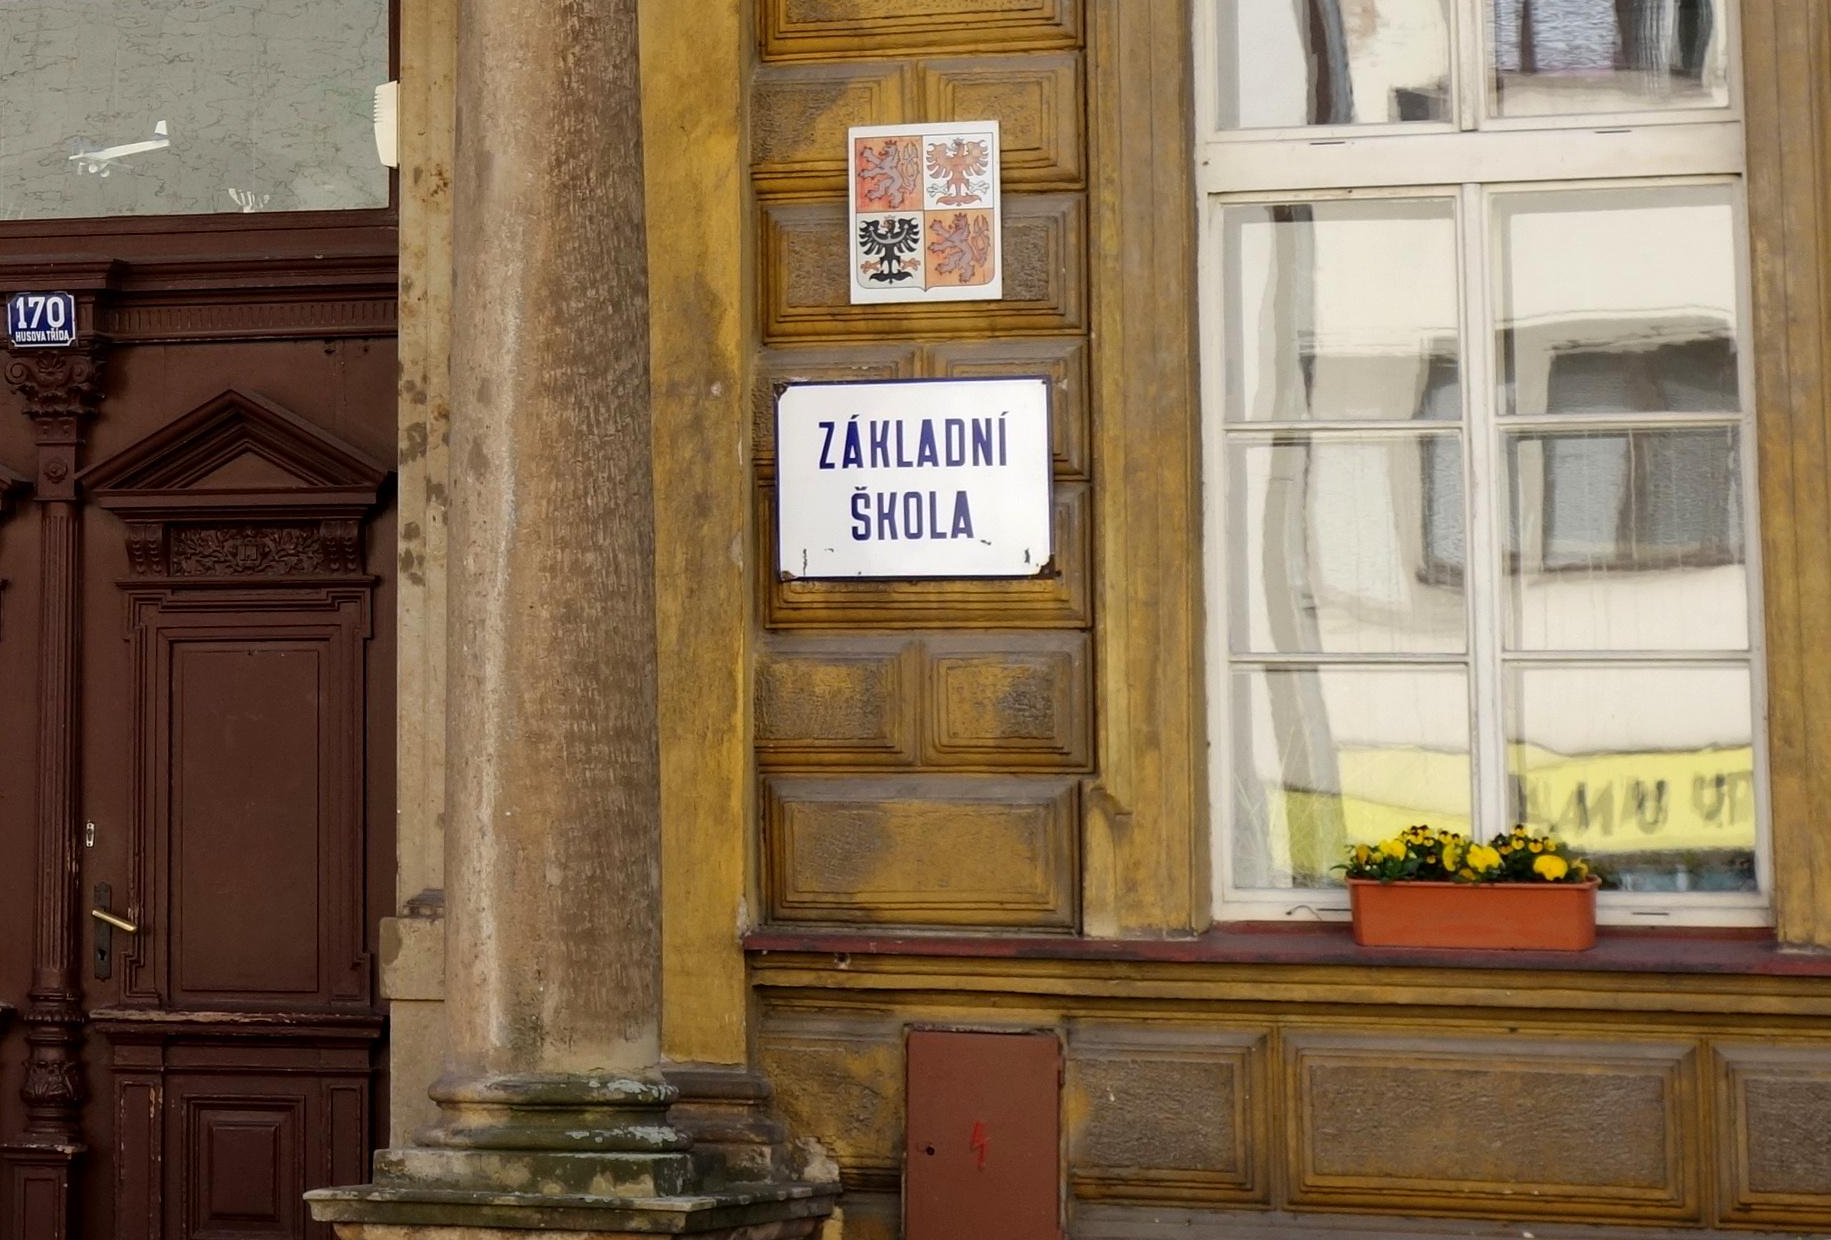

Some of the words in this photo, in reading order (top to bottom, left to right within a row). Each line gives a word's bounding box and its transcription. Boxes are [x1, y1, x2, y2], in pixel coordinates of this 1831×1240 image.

[15, 331, 47, 342] HUSOVA
[47, 327, 70, 342] TŘÍDA
[16, 296, 65, 329] 170
[818, 411, 1009, 470] ZÁKLADNÍ
[850, 486, 975, 541] ŠKOLA
